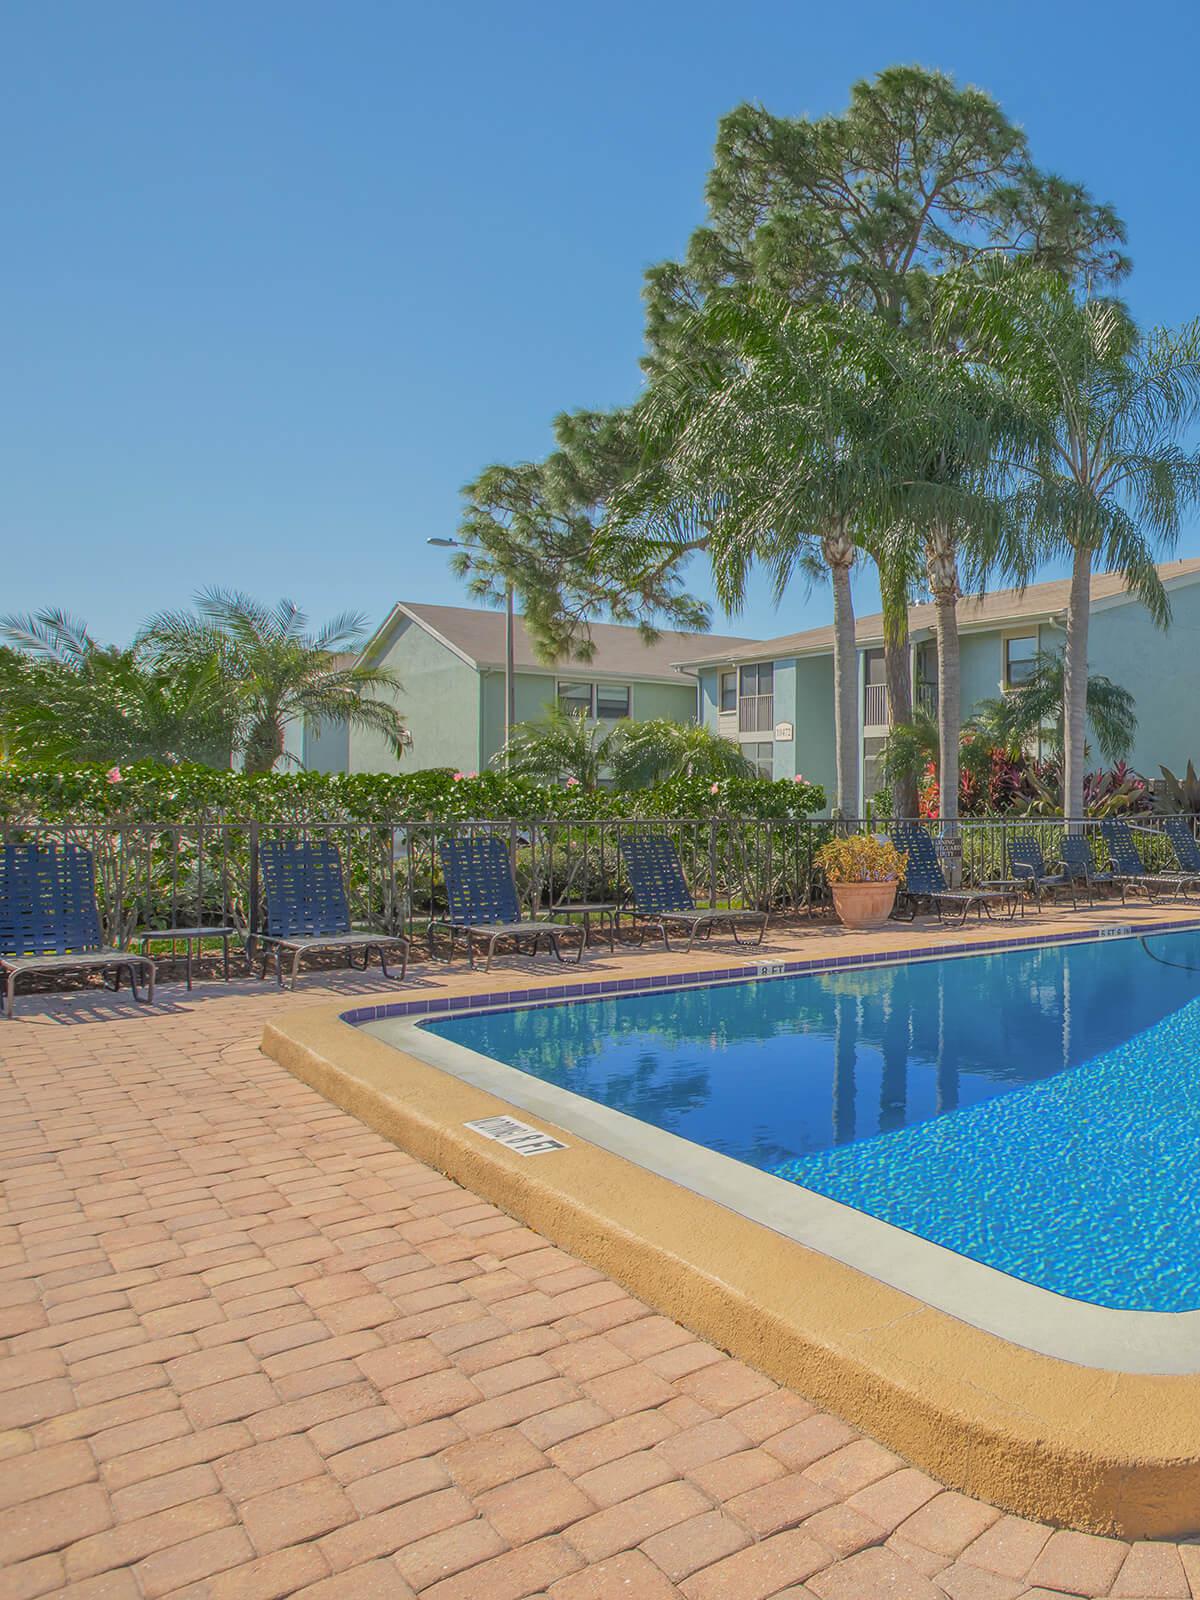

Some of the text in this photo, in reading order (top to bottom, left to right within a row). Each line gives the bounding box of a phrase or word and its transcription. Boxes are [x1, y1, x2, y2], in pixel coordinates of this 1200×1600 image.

[772, 966, 783, 974] FT
[505, 1133, 566, 1154] 8 FT
